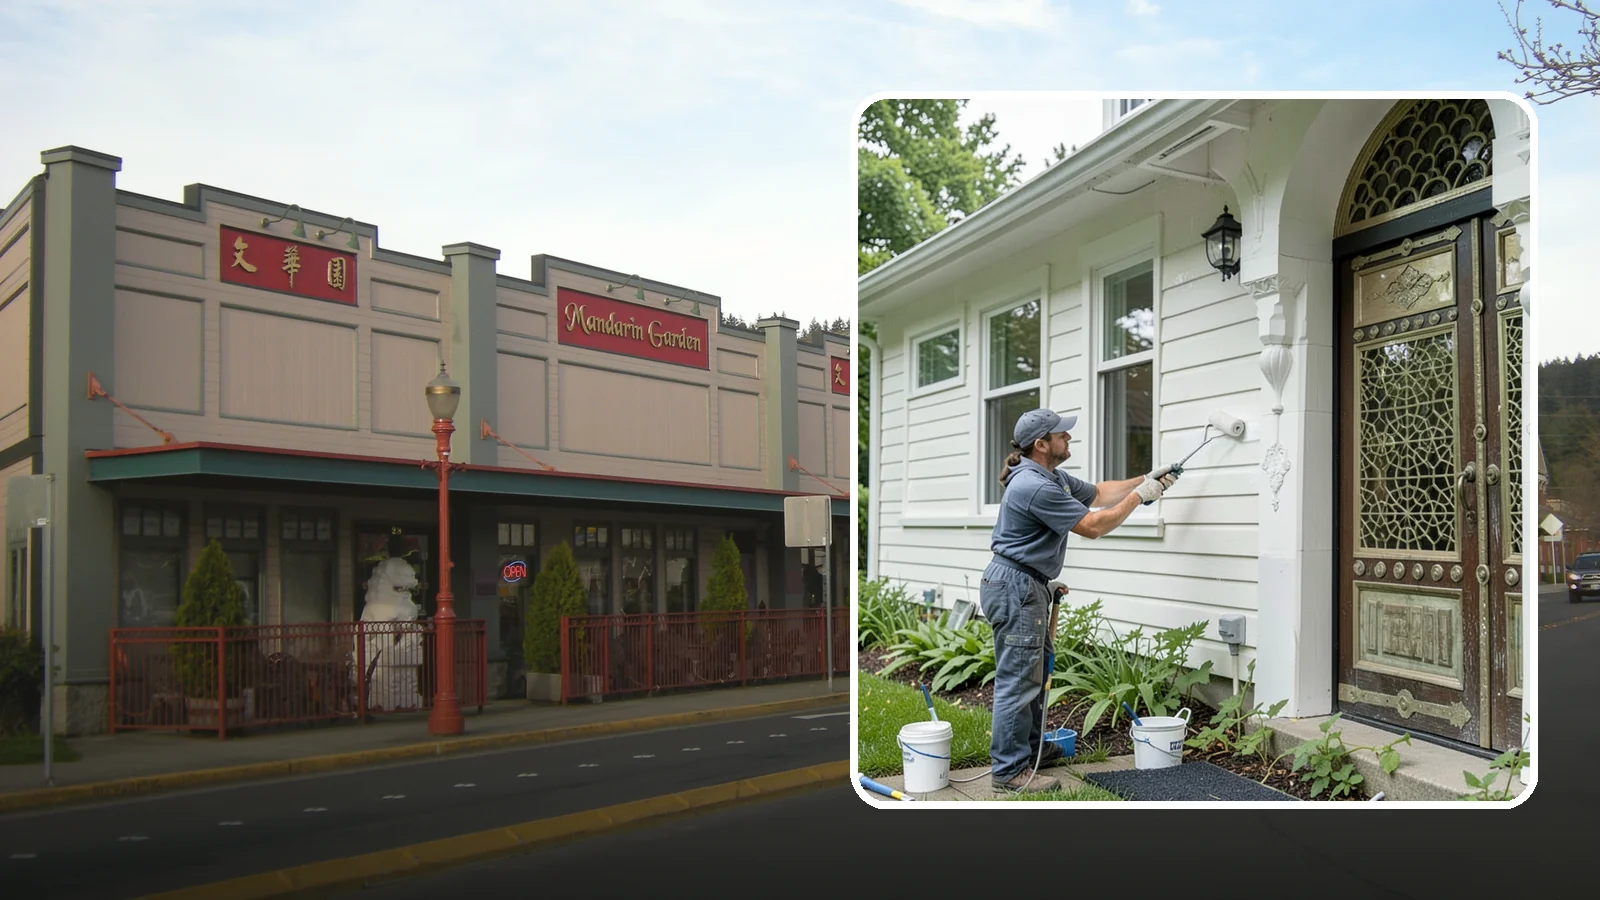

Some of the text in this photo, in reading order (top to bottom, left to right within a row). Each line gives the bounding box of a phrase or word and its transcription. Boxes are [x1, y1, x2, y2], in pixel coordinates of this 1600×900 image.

[564, 302, 701, 352] Mandarin Garden
[503, 565, 527, 578] OPEN
